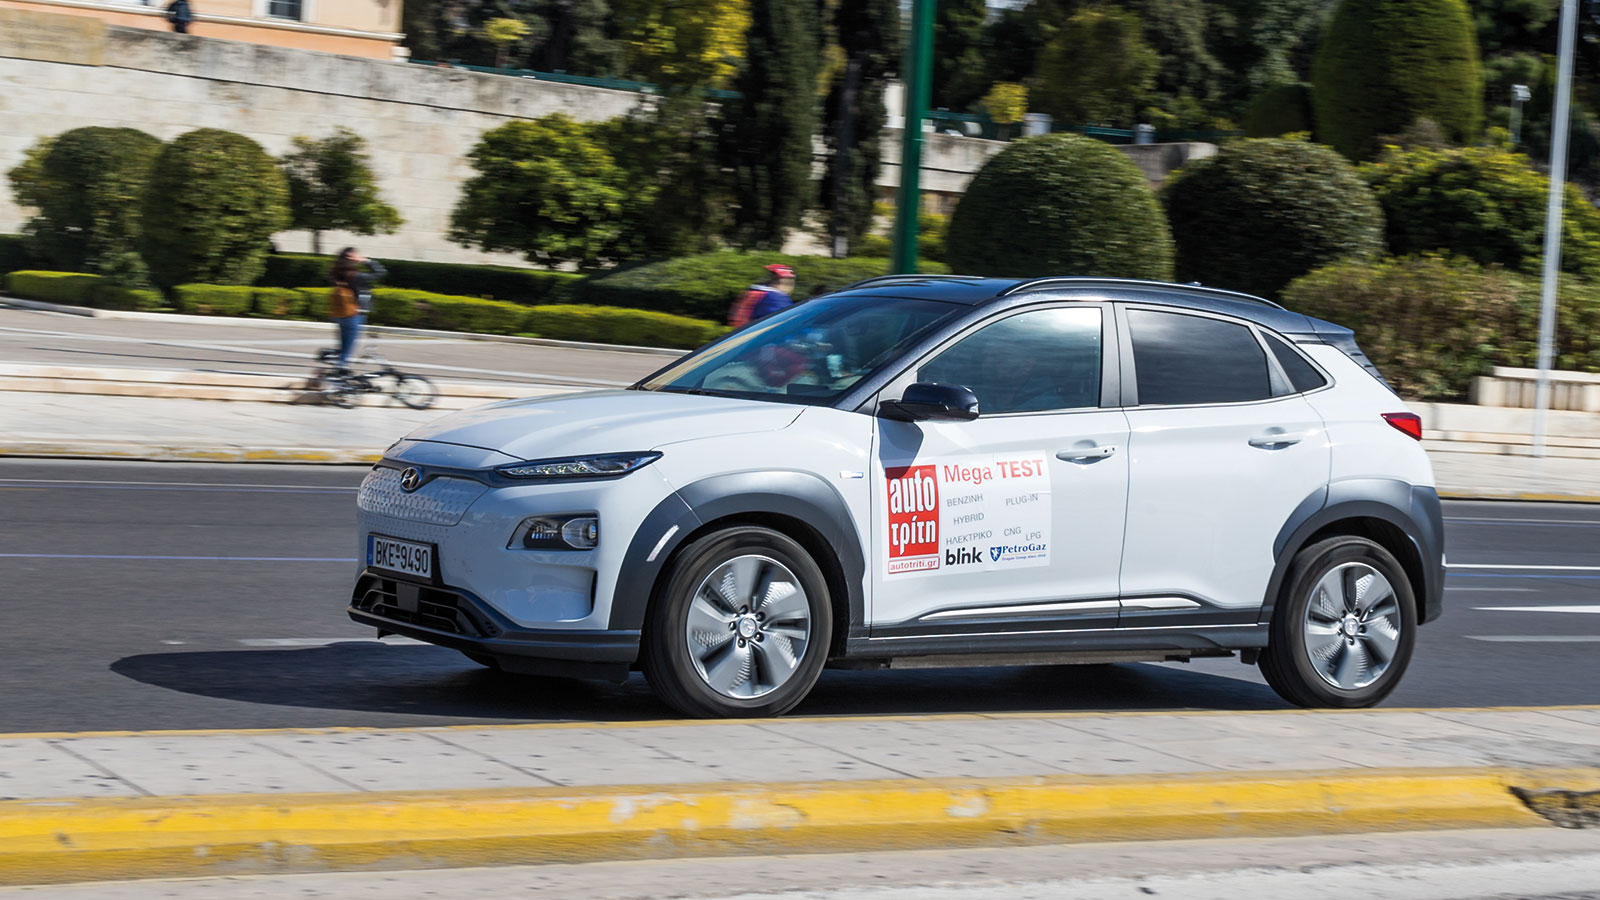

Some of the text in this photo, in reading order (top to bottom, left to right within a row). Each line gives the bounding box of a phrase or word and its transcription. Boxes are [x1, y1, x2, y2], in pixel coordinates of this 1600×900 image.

[944, 459, 1043, 485] Mega TEST
[890, 469, 936, 514] auto
[947, 494, 983, 507] ΒΕΝΖΙΝΗ
[1005, 493, 1039, 506] PLUG-IN
[953, 512, 985, 525] HYBRID
[891, 515, 936, 555] τρίτη
[946, 530, 993, 546] ΗΛΕΚΤΡΙΚΟ
[1004, 527, 1022, 537] CNG
[1025, 531, 1042, 541] LPG
[1002, 543, 1047, 554] PetroGaz
[945, 547, 983, 566] blink
[890, 559, 938, 571] autotriti.gr
